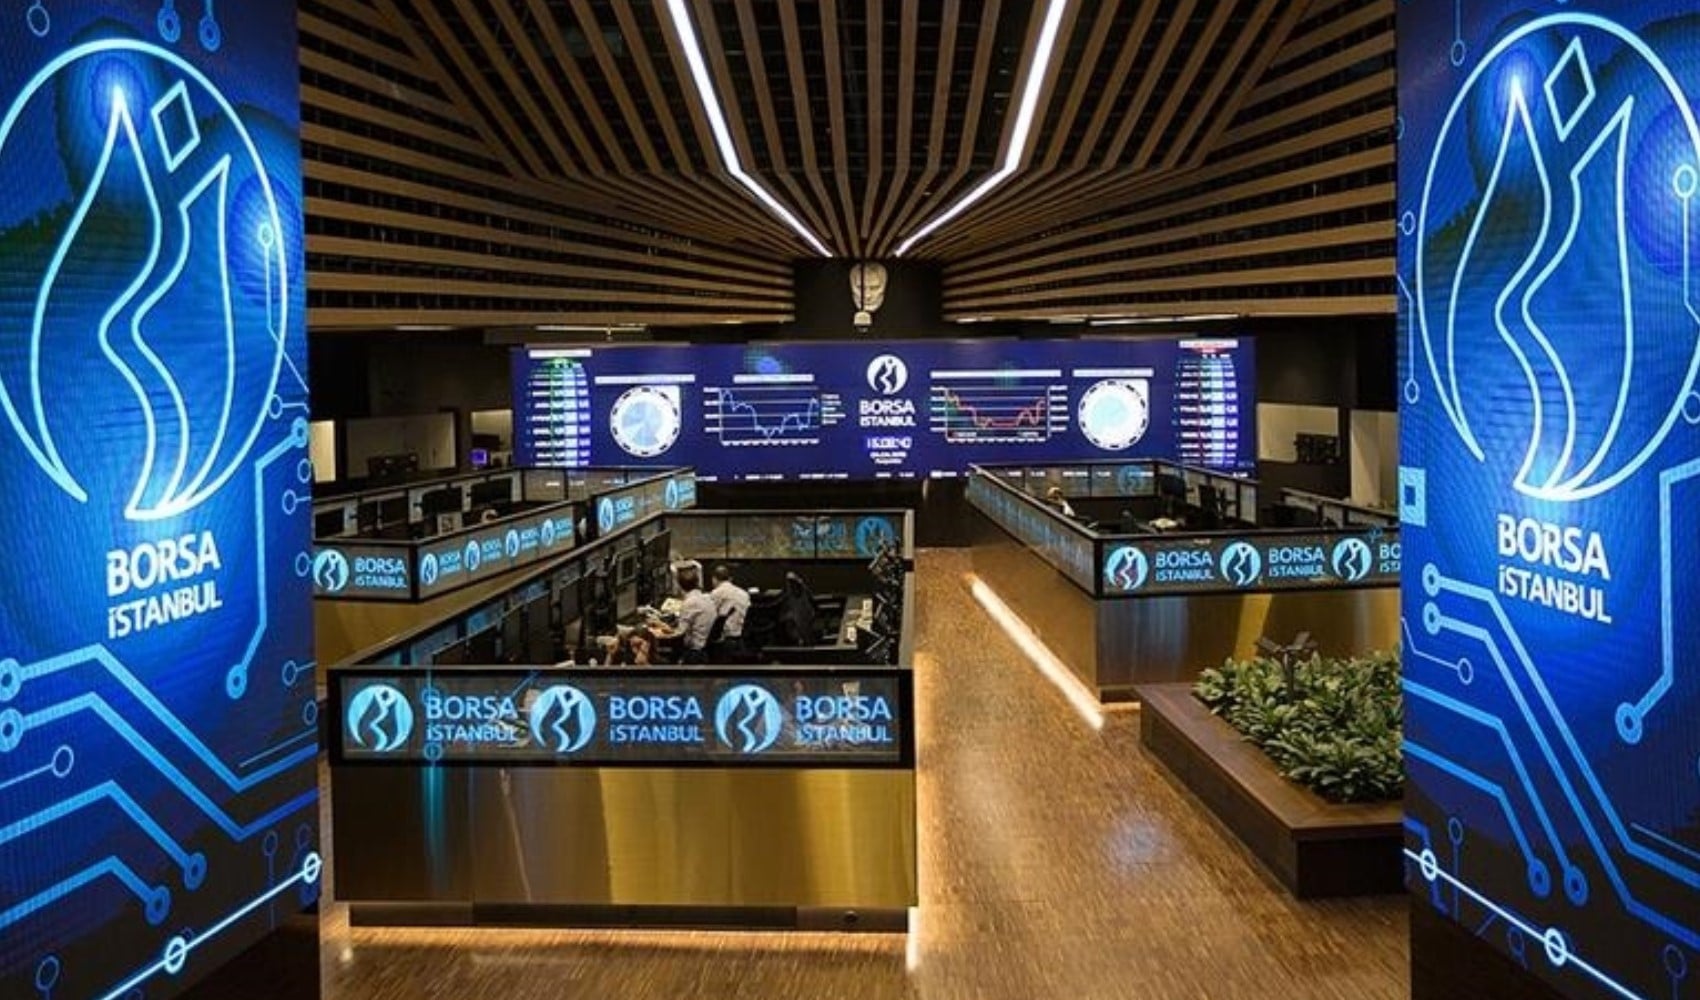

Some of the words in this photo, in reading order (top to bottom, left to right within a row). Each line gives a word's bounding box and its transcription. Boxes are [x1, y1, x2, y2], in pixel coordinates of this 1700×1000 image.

[860, 399, 915, 414] BORSA
[1269, 547, 1325, 564] BORSA
[1498, 513, 1611, 580] BORSA
[106, 530, 221, 597] BORSA
[355, 557, 407, 574] BORSA
[1156, 551, 1214, 568] BORSA
[426, 696, 519, 719] BORSA
[610, 696, 703, 720] BORSA
[796, 696, 892, 721] BORSA
